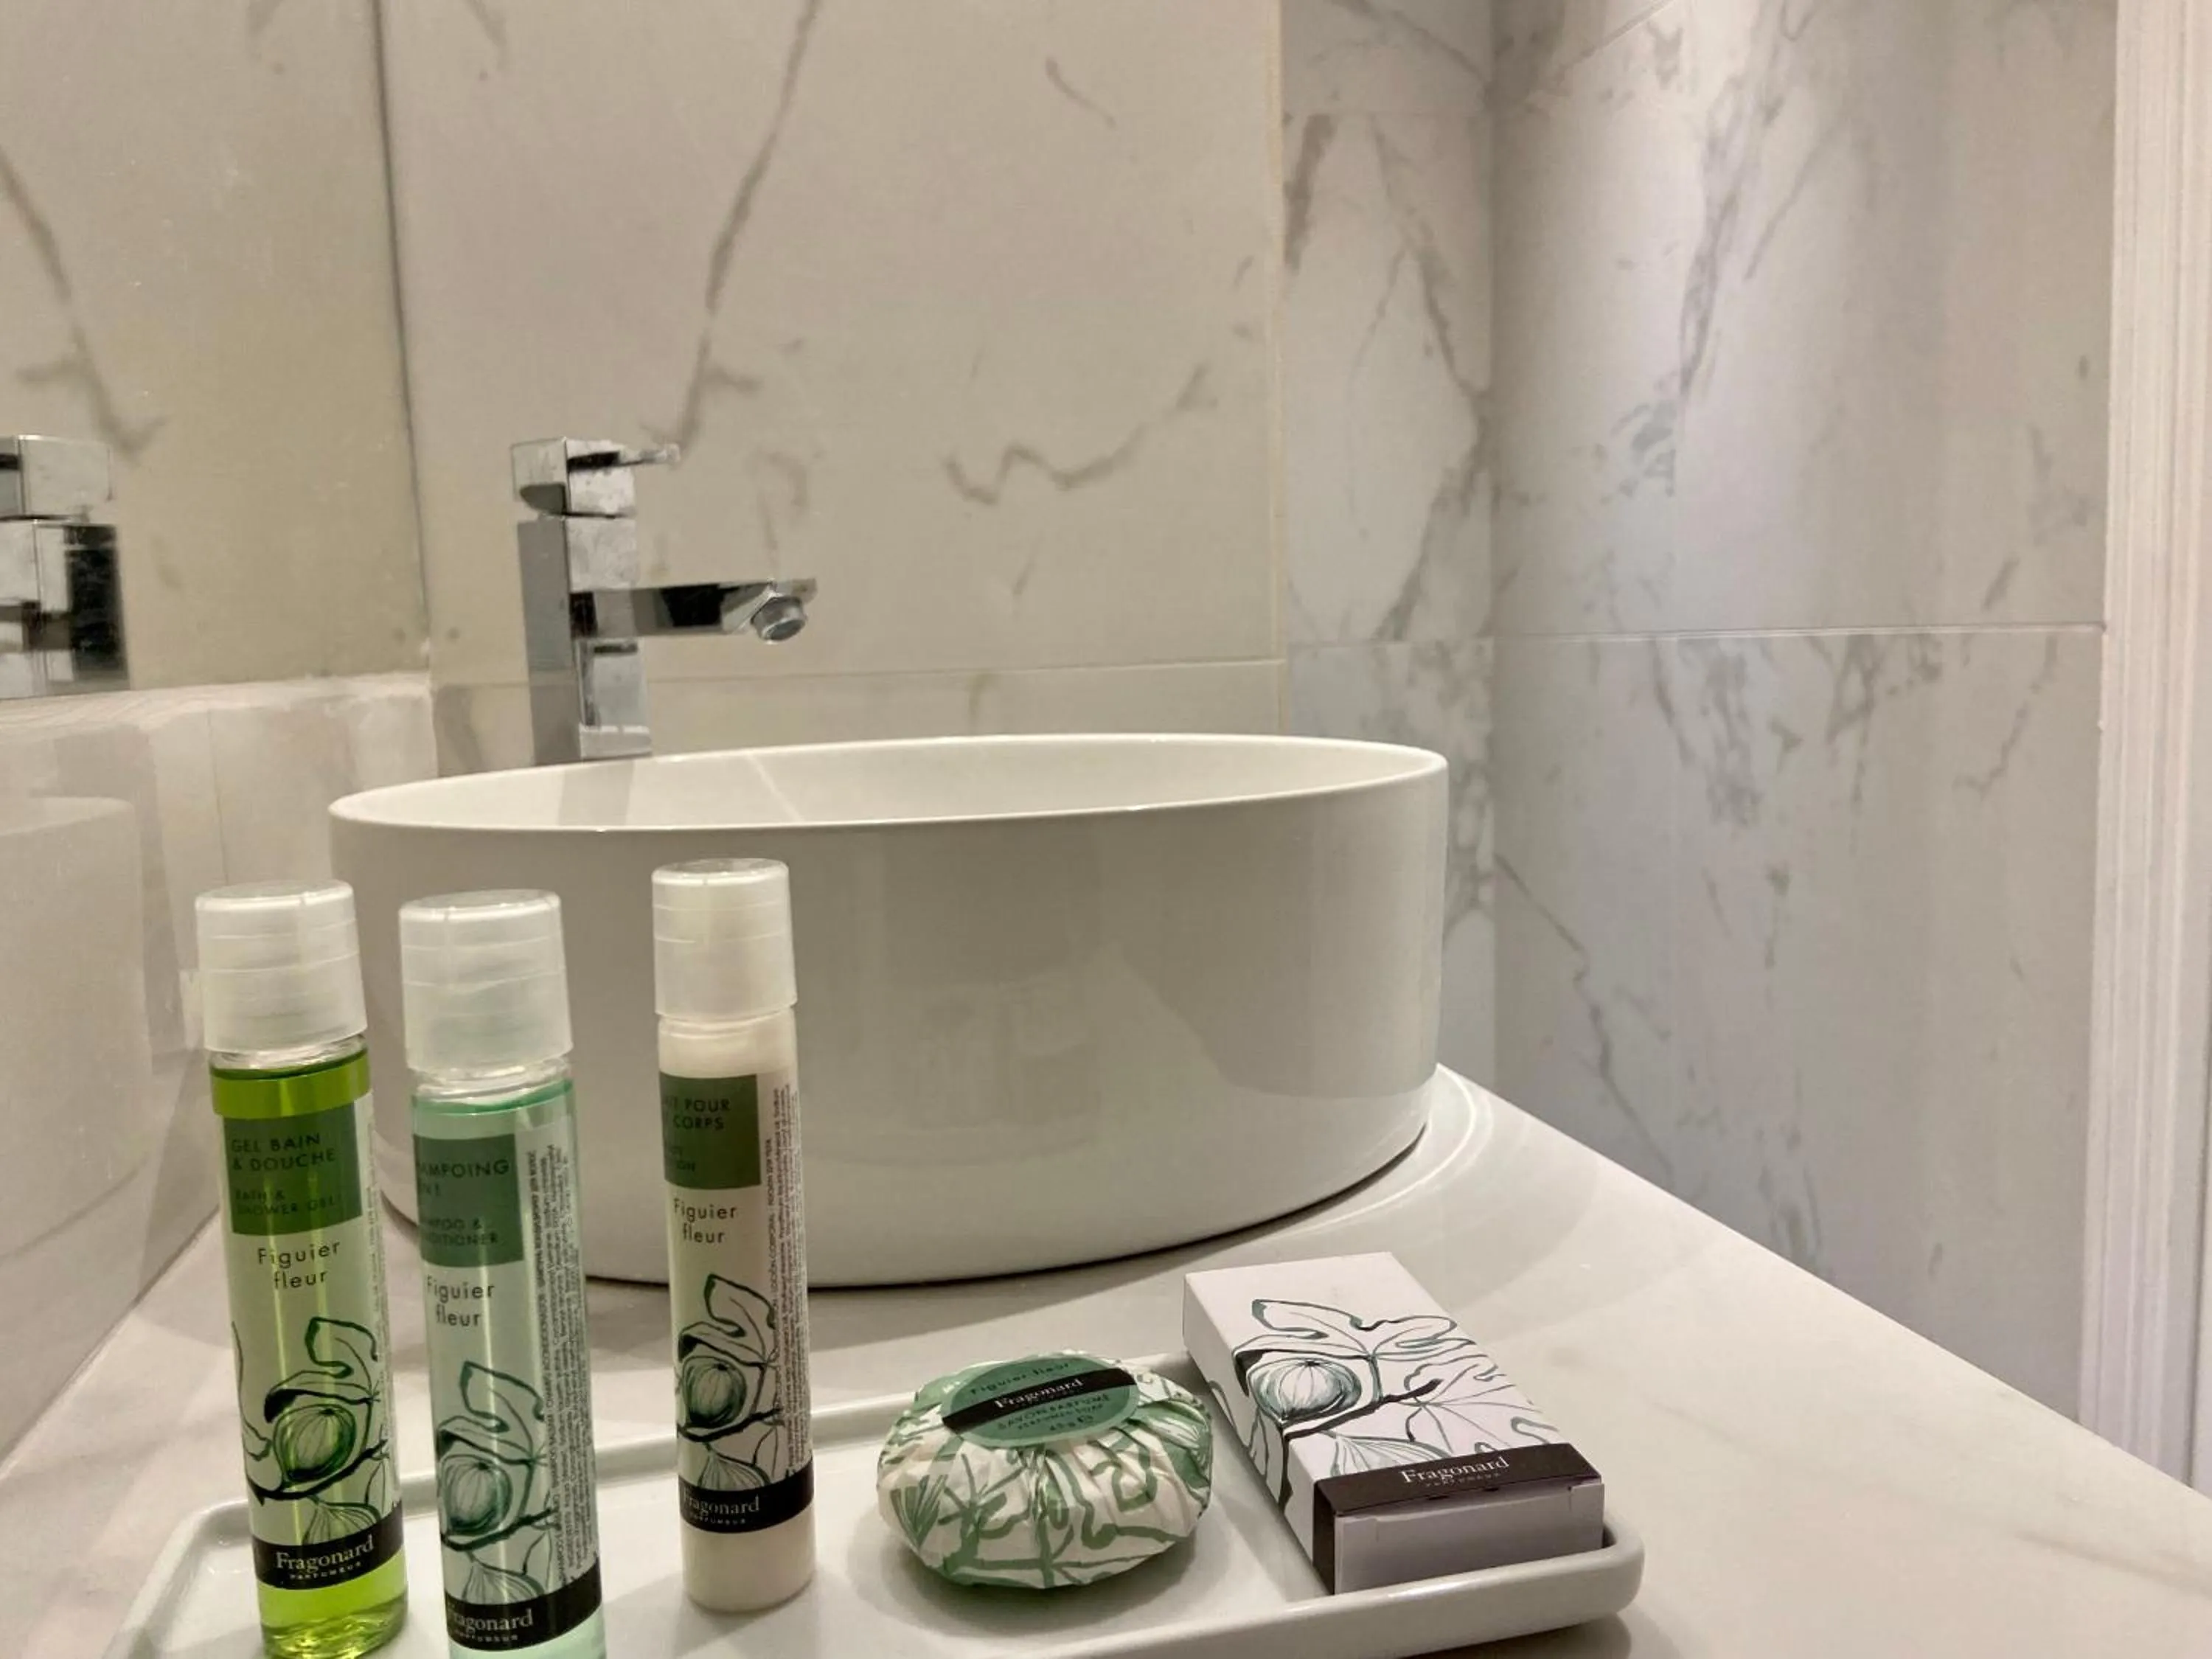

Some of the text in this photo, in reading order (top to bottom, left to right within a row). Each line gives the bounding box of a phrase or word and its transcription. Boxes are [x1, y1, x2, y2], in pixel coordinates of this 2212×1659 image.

[684, 1098, 731, 1113] POUR
[672, 1113, 725, 1131] CORPS
[231, 1133, 320, 1153] GEL BAIN
[249, 1149, 335, 1172] DOUCHE
[673, 1197, 738, 1224] Figuier
[682, 1221, 726, 1244] fleur
[257, 1241, 341, 1269] Figuier
[274, 1270, 328, 1289] fleur
[425, 1274, 495, 1304] Figuier
[436, 1304, 481, 1326] fleur
[994, 1377, 1085, 1408] Fragonard
[1399, 1455, 1511, 1484] Fragonard
[276, 1533, 375, 1574] Fragonard
